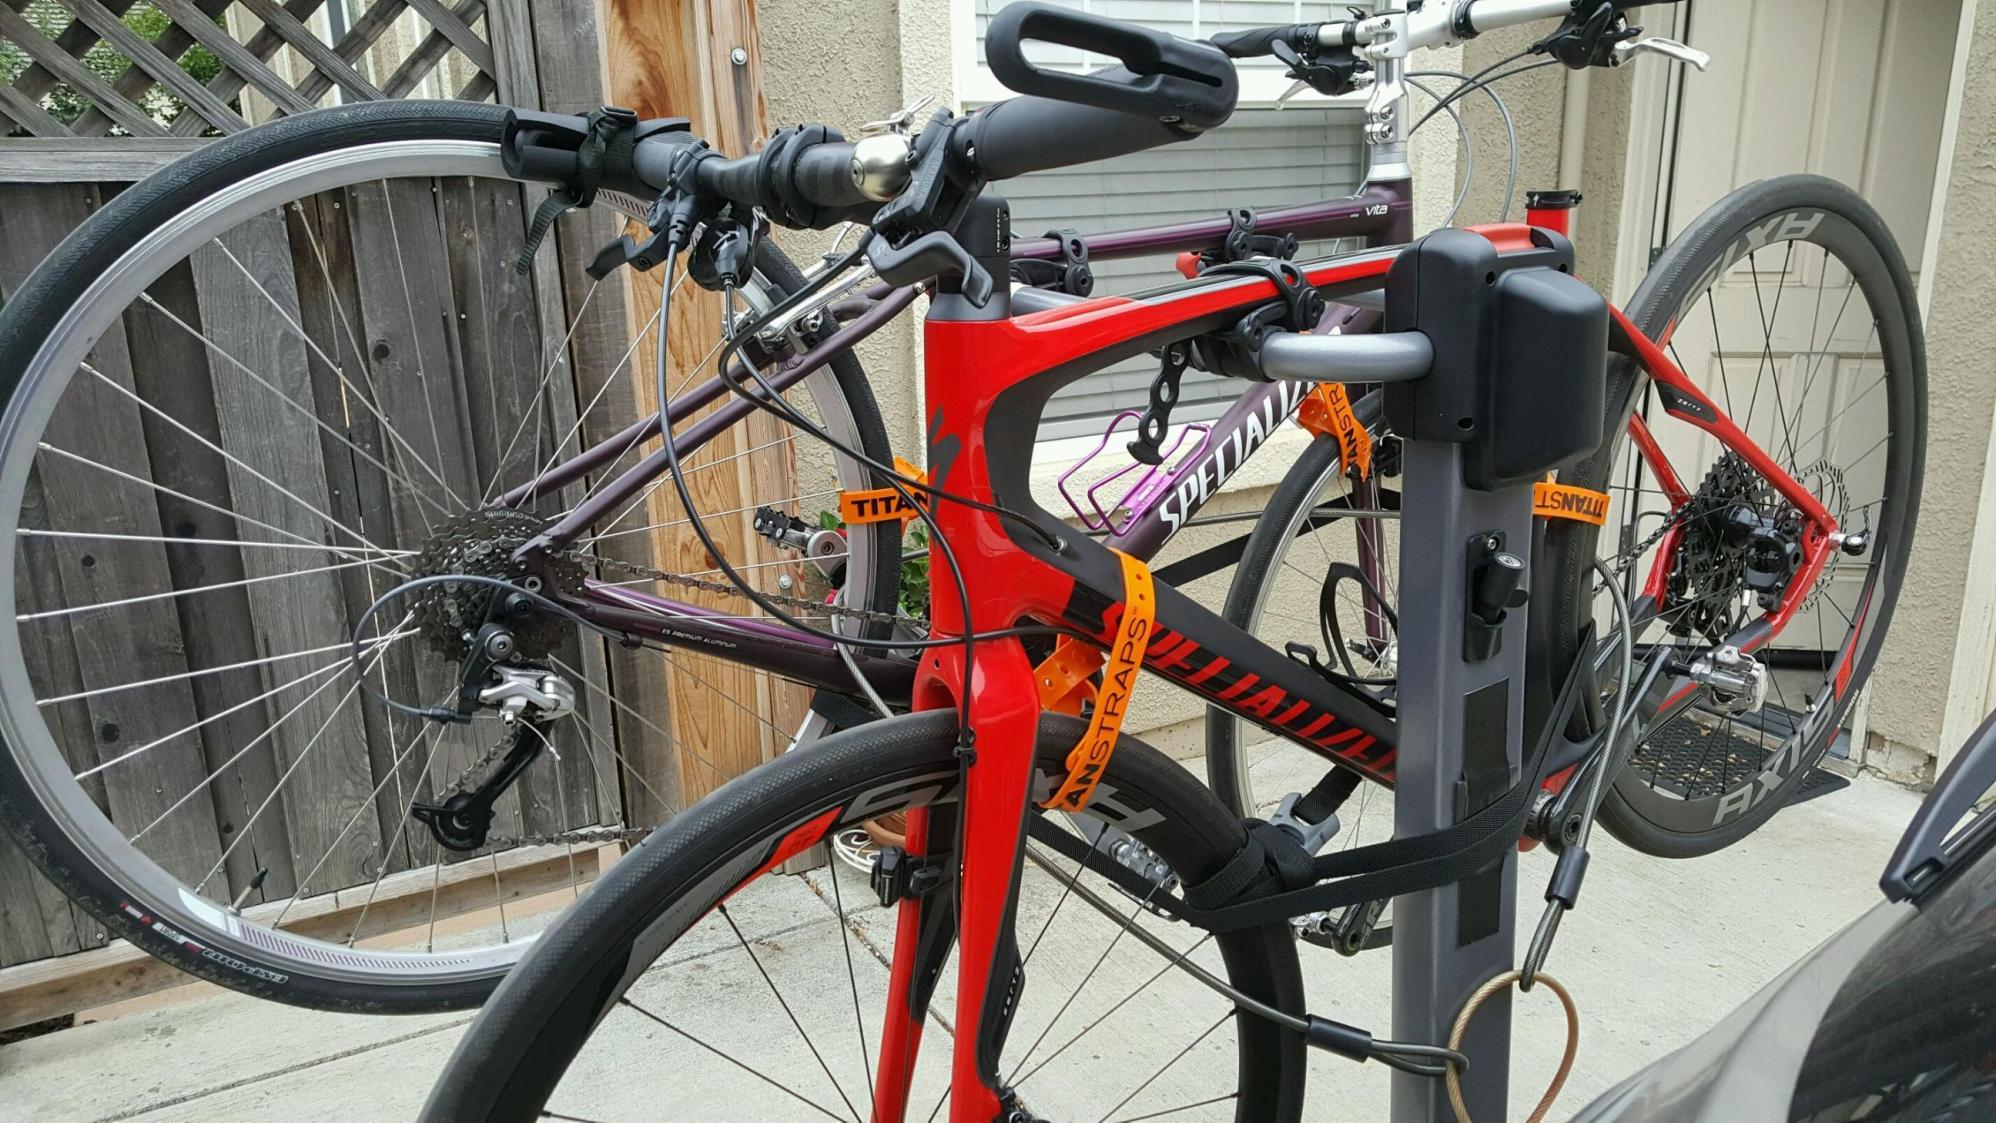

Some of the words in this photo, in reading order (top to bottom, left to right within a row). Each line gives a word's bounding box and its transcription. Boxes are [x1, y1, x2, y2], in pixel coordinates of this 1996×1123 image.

[1365, 203, 1389, 217] vita
[1158, 380, 1316, 542] SPECIALI
[1712, 684, 1835, 827] AXIS
